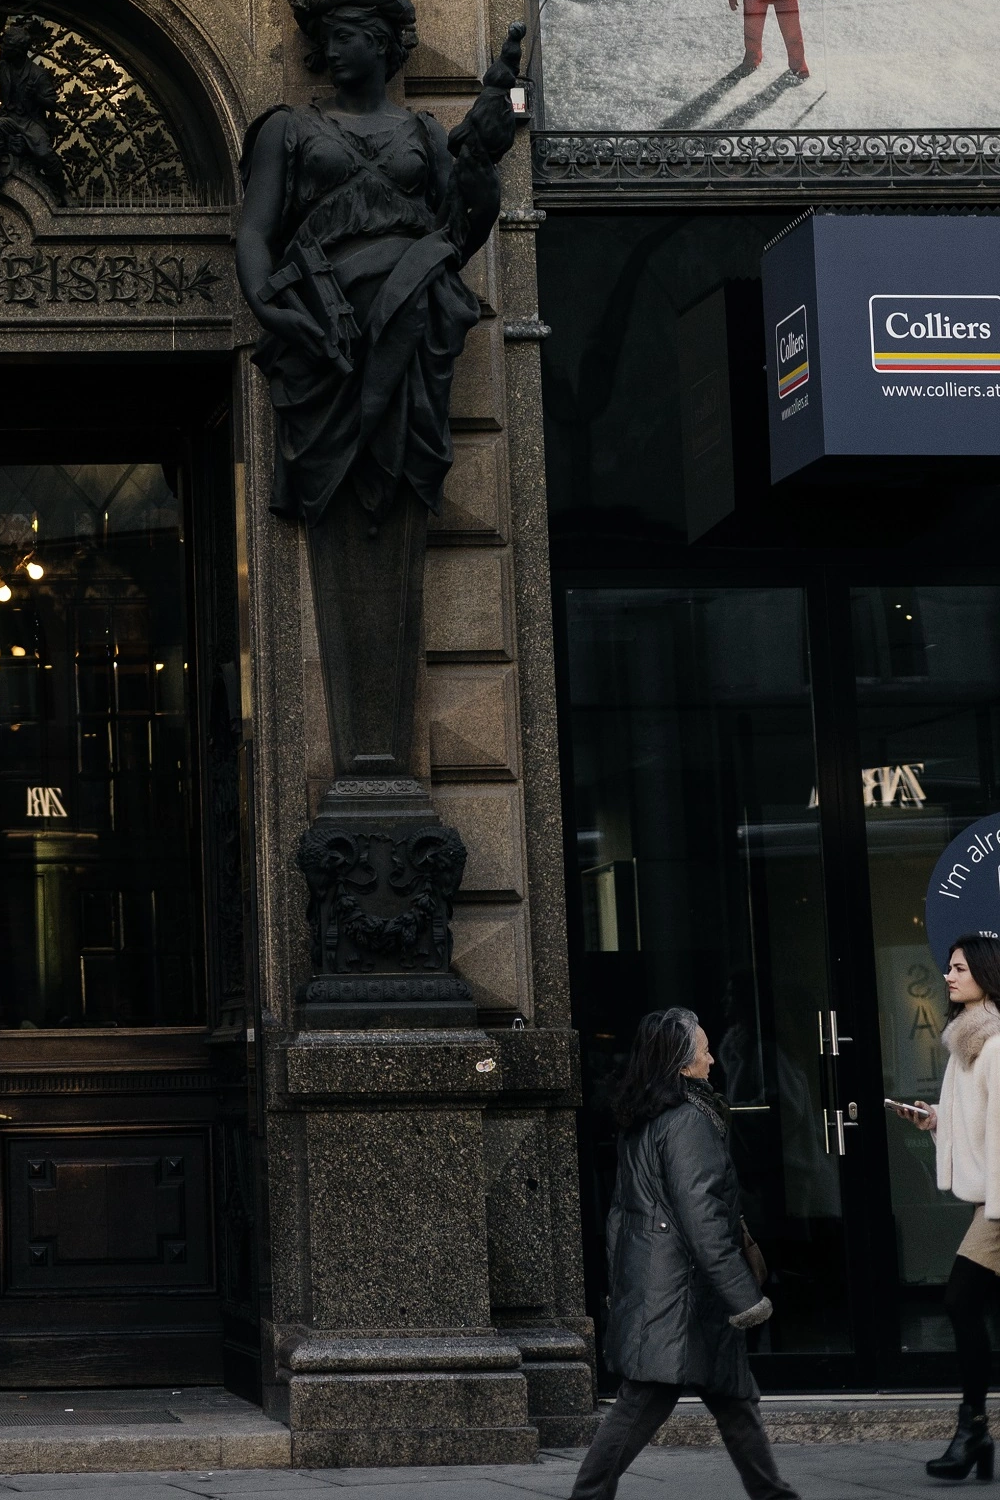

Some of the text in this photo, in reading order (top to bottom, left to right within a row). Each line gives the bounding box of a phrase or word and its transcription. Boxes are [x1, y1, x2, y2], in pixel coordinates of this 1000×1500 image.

[1, 254, 186, 305] EISEN
[886, 312, 991, 339] Colliers
[780, 332, 805, 363] Colliers
[882, 382, 1000, 398] www.colliers.at
